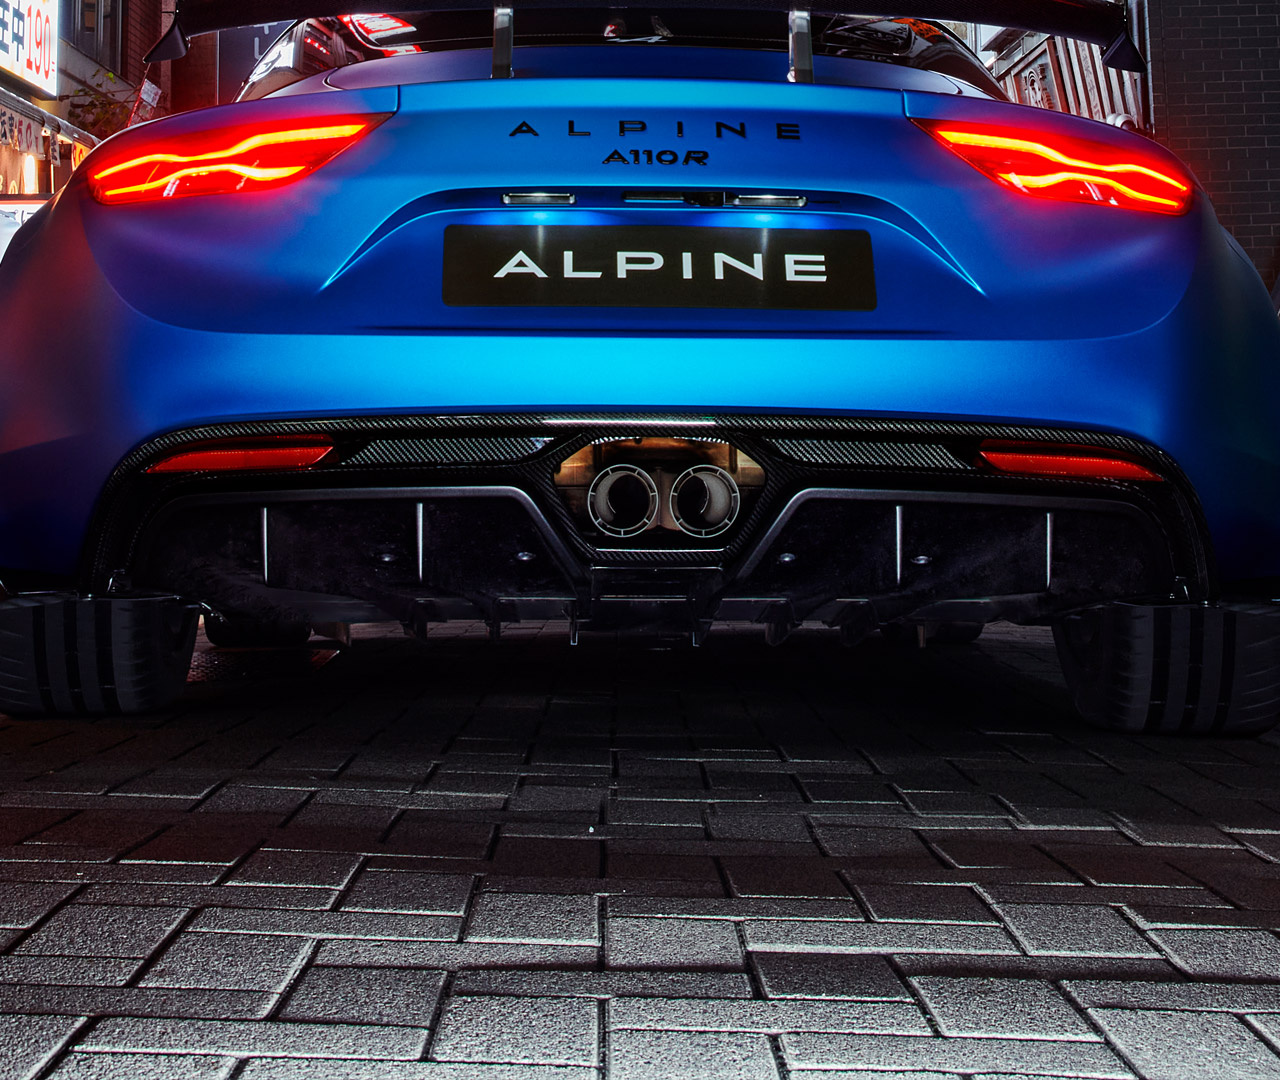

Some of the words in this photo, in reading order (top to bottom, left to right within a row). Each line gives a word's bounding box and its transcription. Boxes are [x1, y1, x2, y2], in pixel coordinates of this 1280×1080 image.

[509, 120, 801, 140] ALPINE
[602, 149, 710, 166] A110R
[493, 250, 828, 283] ALPINE
